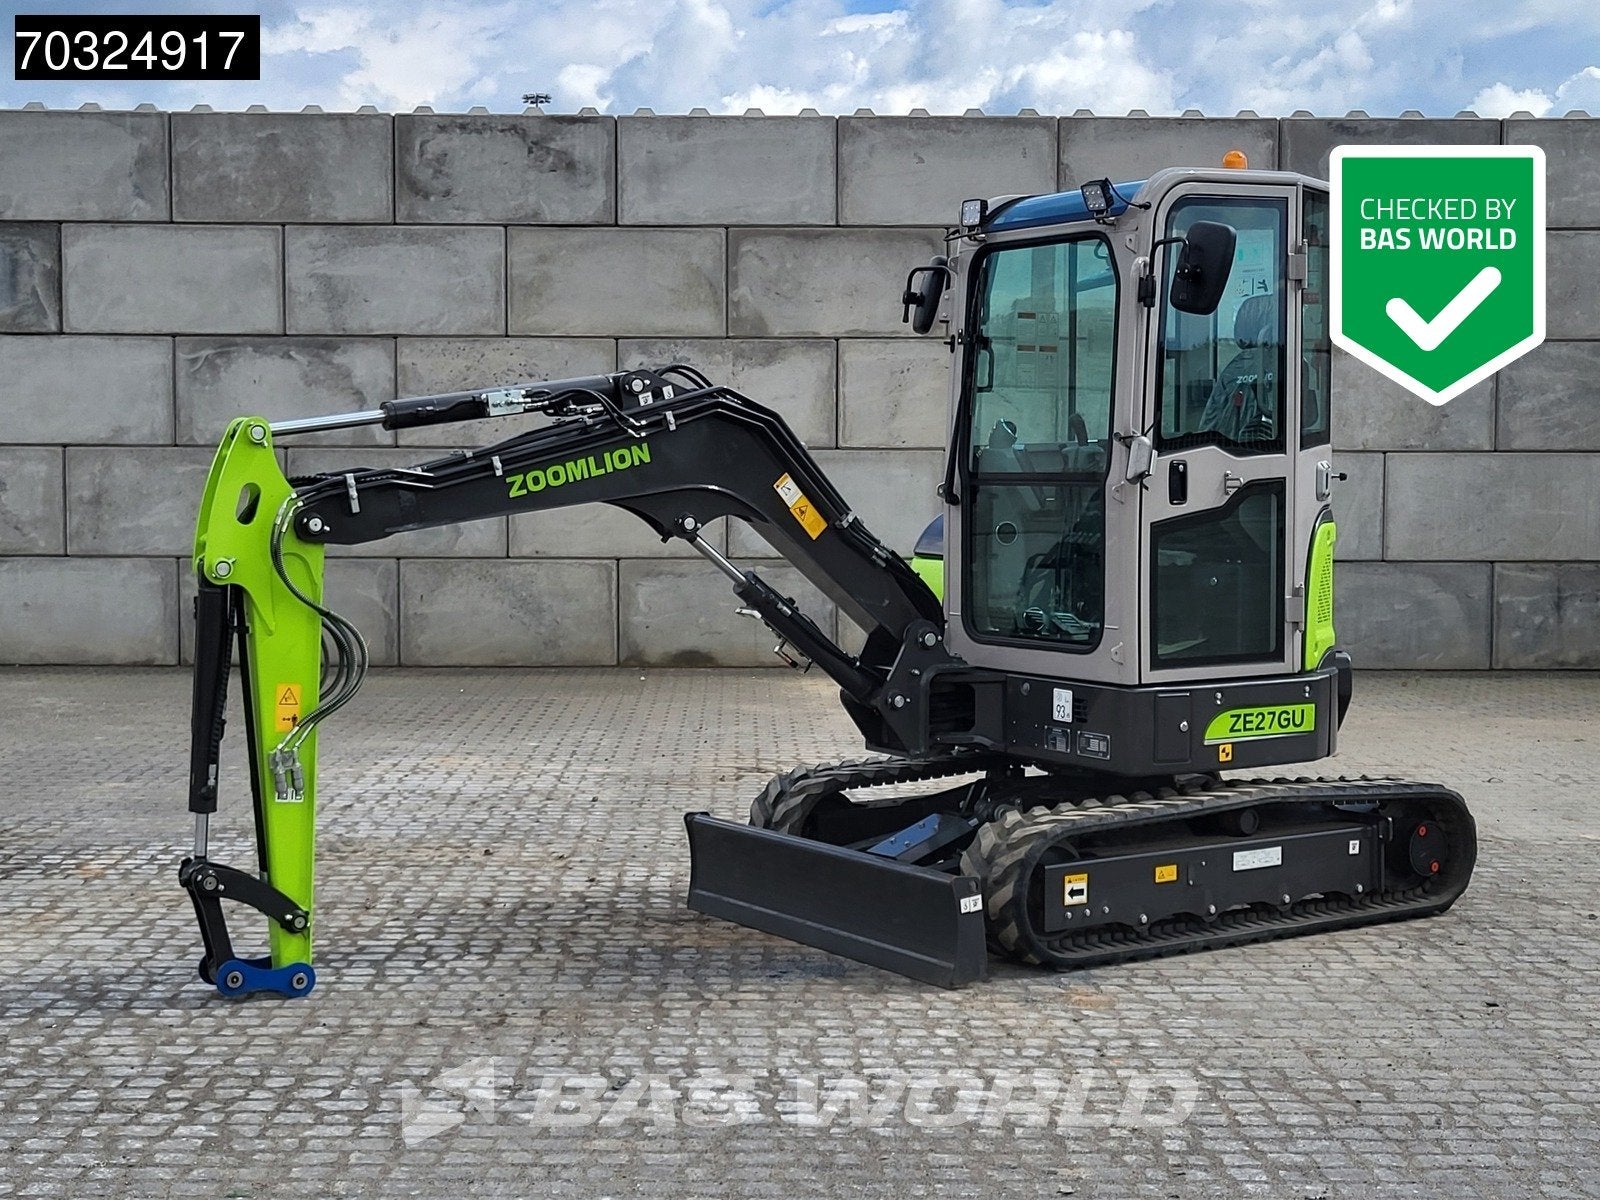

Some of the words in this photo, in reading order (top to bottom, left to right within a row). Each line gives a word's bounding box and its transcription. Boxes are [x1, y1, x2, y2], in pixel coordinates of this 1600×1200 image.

[505, 442, 651, 499] ZOOMLION
[1056, 704, 1066, 719] 93
[1229, 708, 1305, 733] ZE27GU
